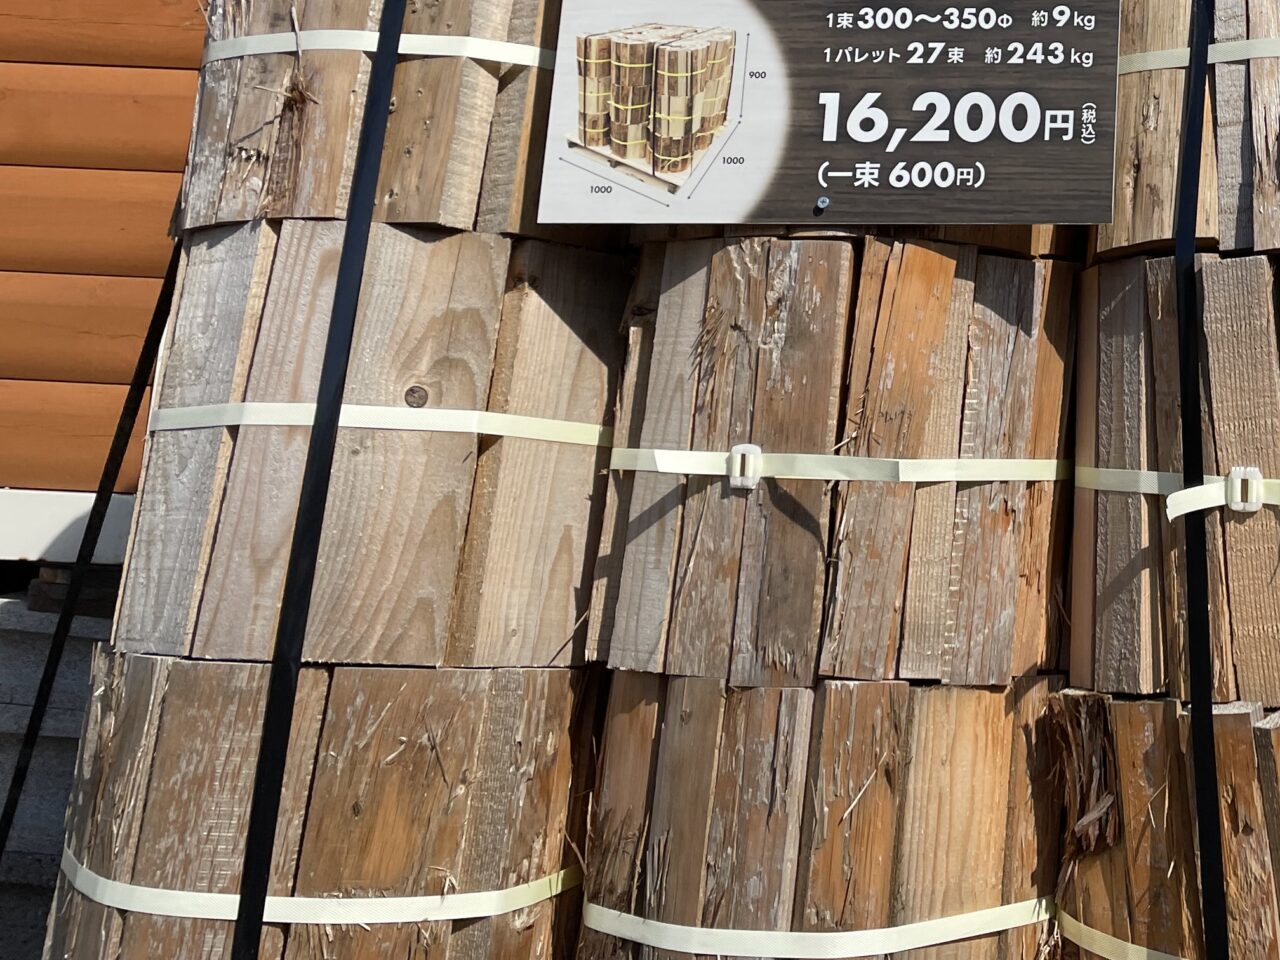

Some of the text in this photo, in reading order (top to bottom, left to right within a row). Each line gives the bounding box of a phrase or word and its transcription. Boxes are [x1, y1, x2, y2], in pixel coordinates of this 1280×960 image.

[748, 71, 767, 79] 900
[818, 91, 1075, 153] 16,200円
[721, 156, 745, 165] 1000
[589, 185, 613, 194] 1000
